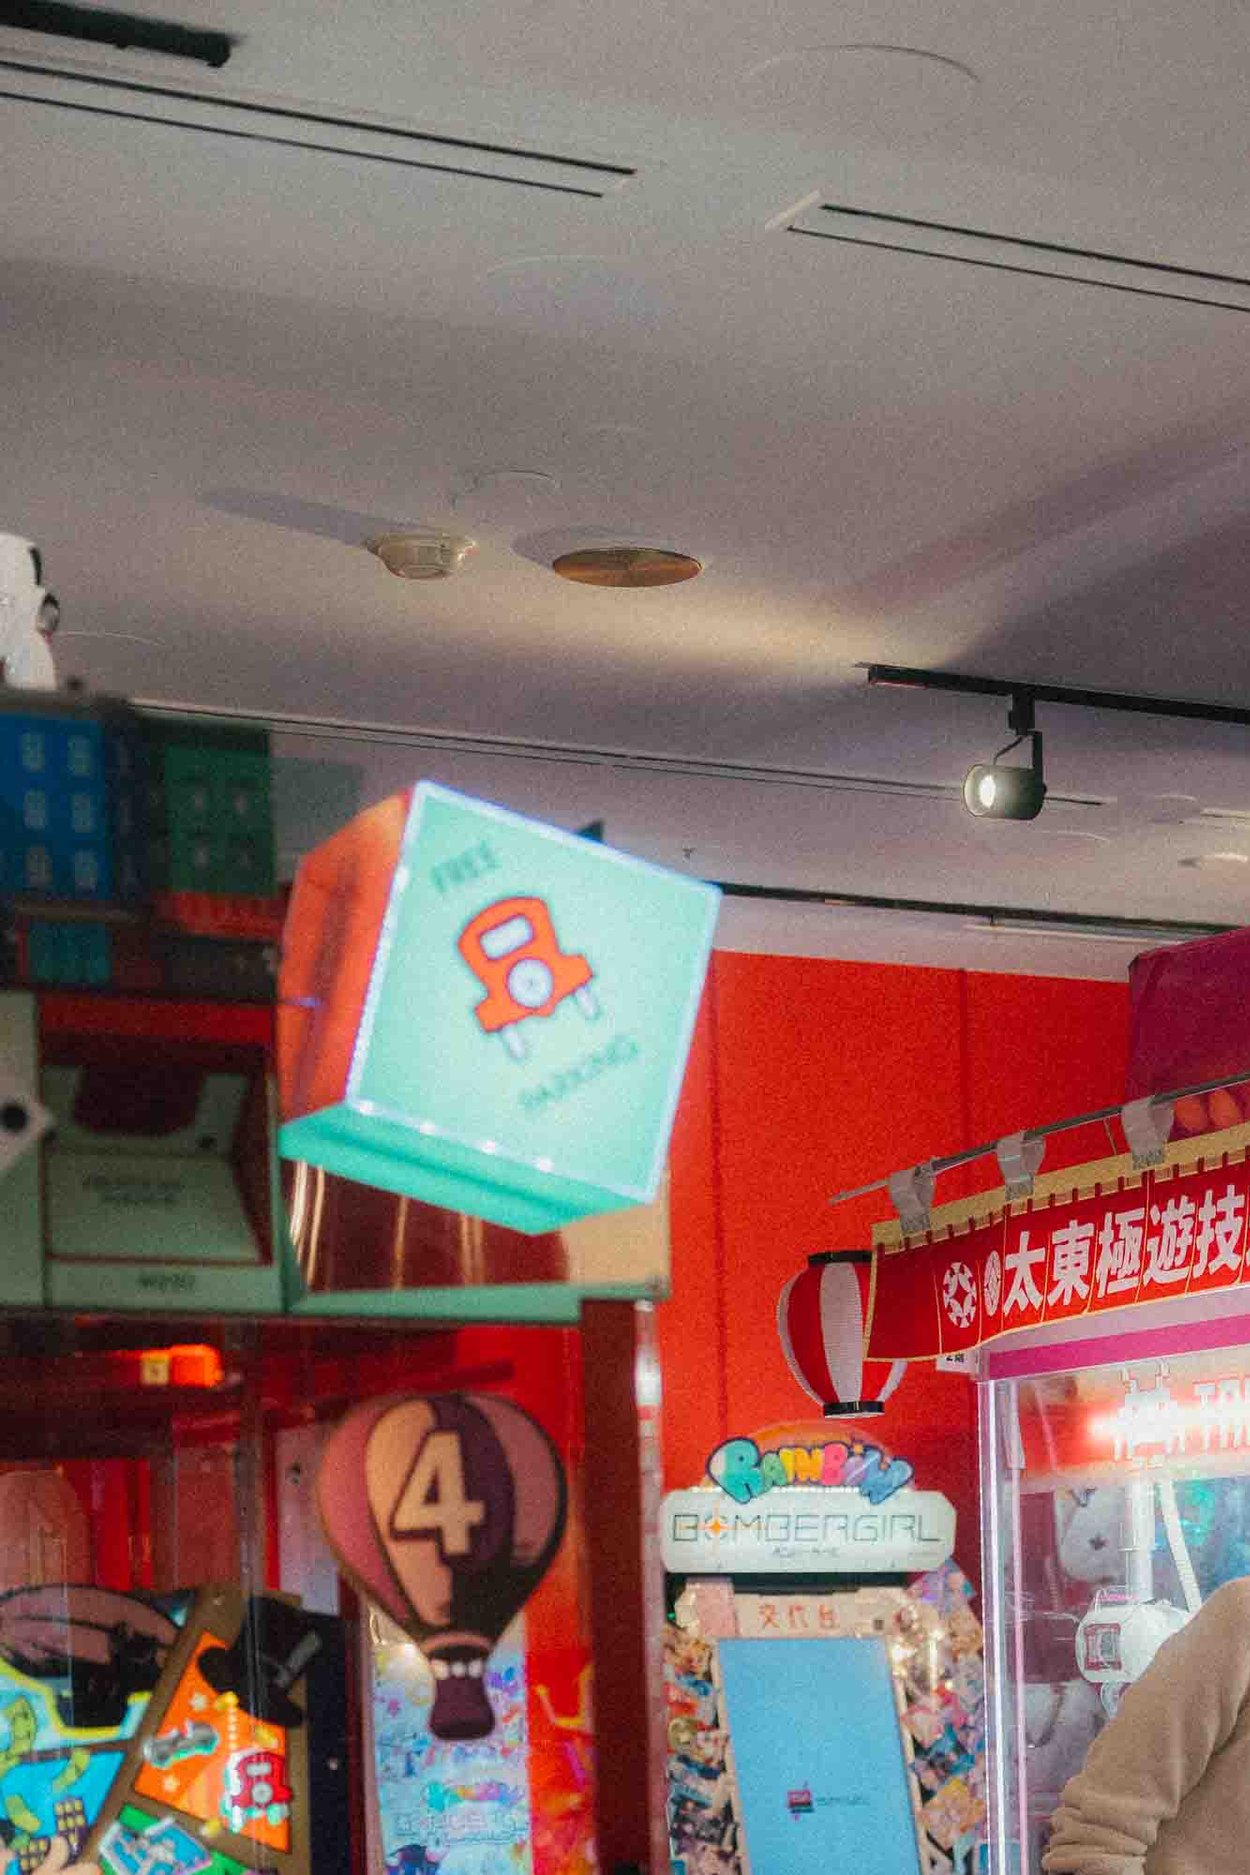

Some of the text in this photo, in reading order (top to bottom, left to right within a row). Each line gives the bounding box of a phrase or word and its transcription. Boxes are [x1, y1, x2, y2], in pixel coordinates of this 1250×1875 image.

[394, 1430, 484, 1553] 4
[707, 1437, 914, 1504] RAINBOW
[673, 1513, 942, 1542] BOMBERGIRL
